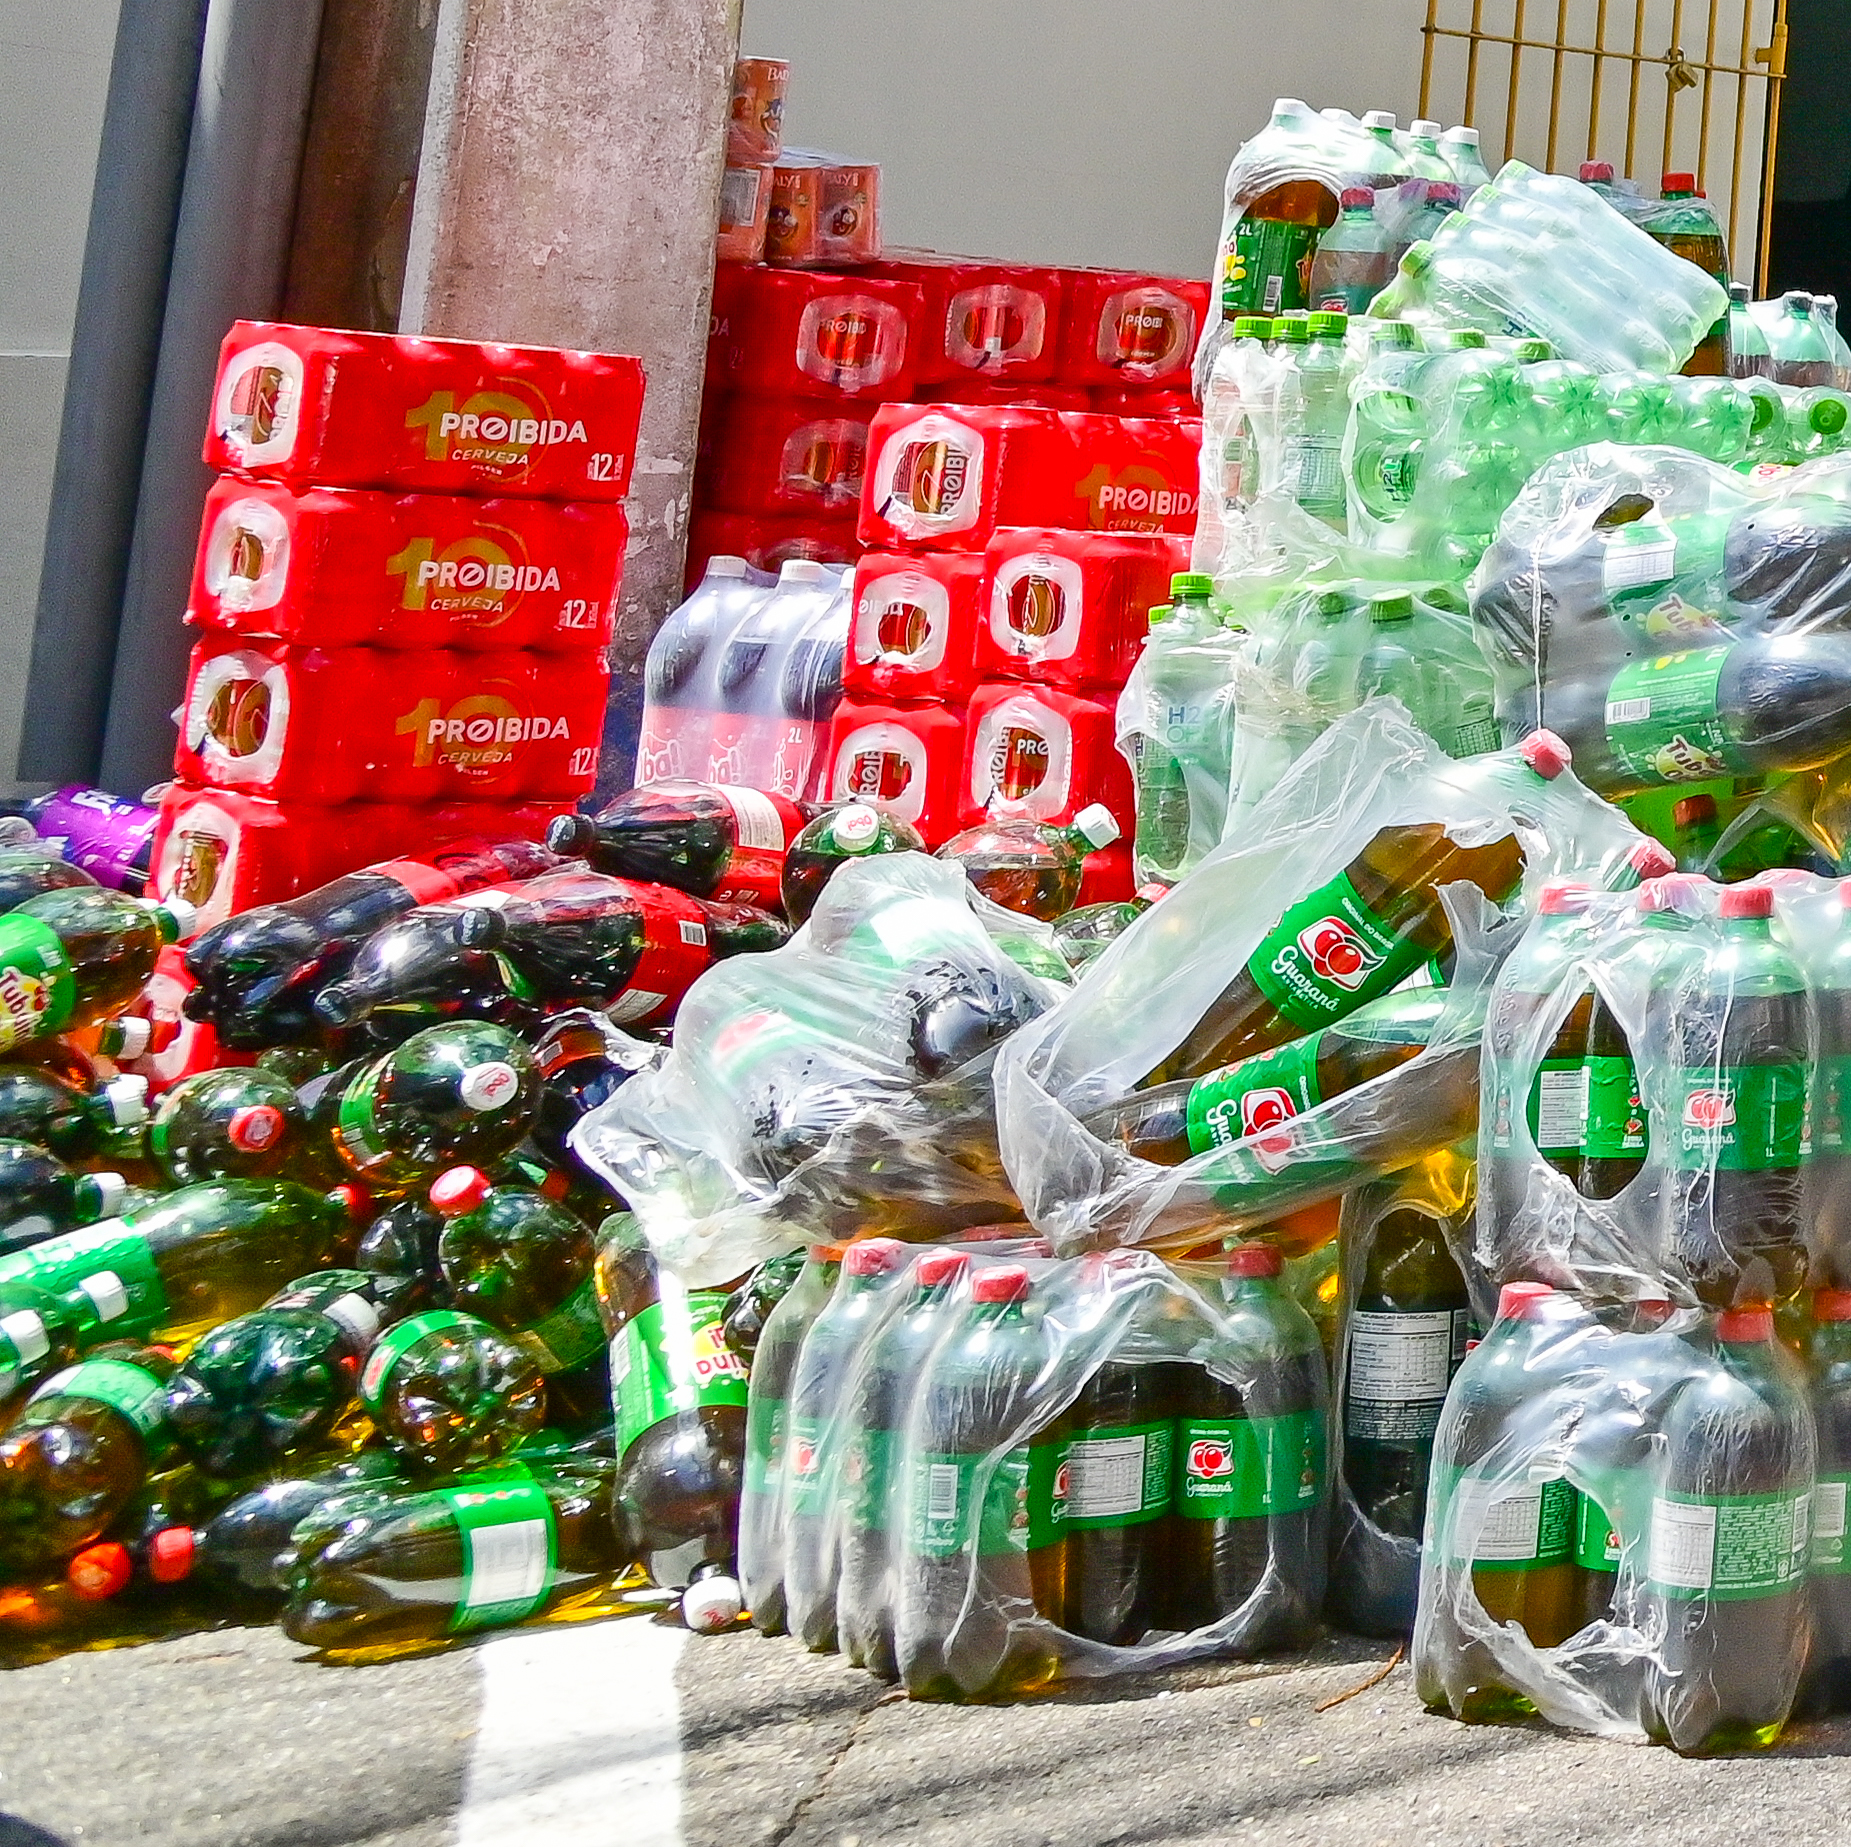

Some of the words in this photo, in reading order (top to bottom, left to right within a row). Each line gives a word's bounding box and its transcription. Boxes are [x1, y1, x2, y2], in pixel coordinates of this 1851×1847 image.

[1239, 222, 1253, 236] 2L
[452, 449, 529, 464] CERVEJA
[590, 453, 612, 481] 12
[430, 597, 503, 613] CERVEJA
[564, 599, 586, 628] 12
[788, 726, 803, 744] 2L
[437, 751, 513, 766] CERVEJA
[573, 747, 593, 775] 12
[1269, 944, 1341, 1014] Guaraná
